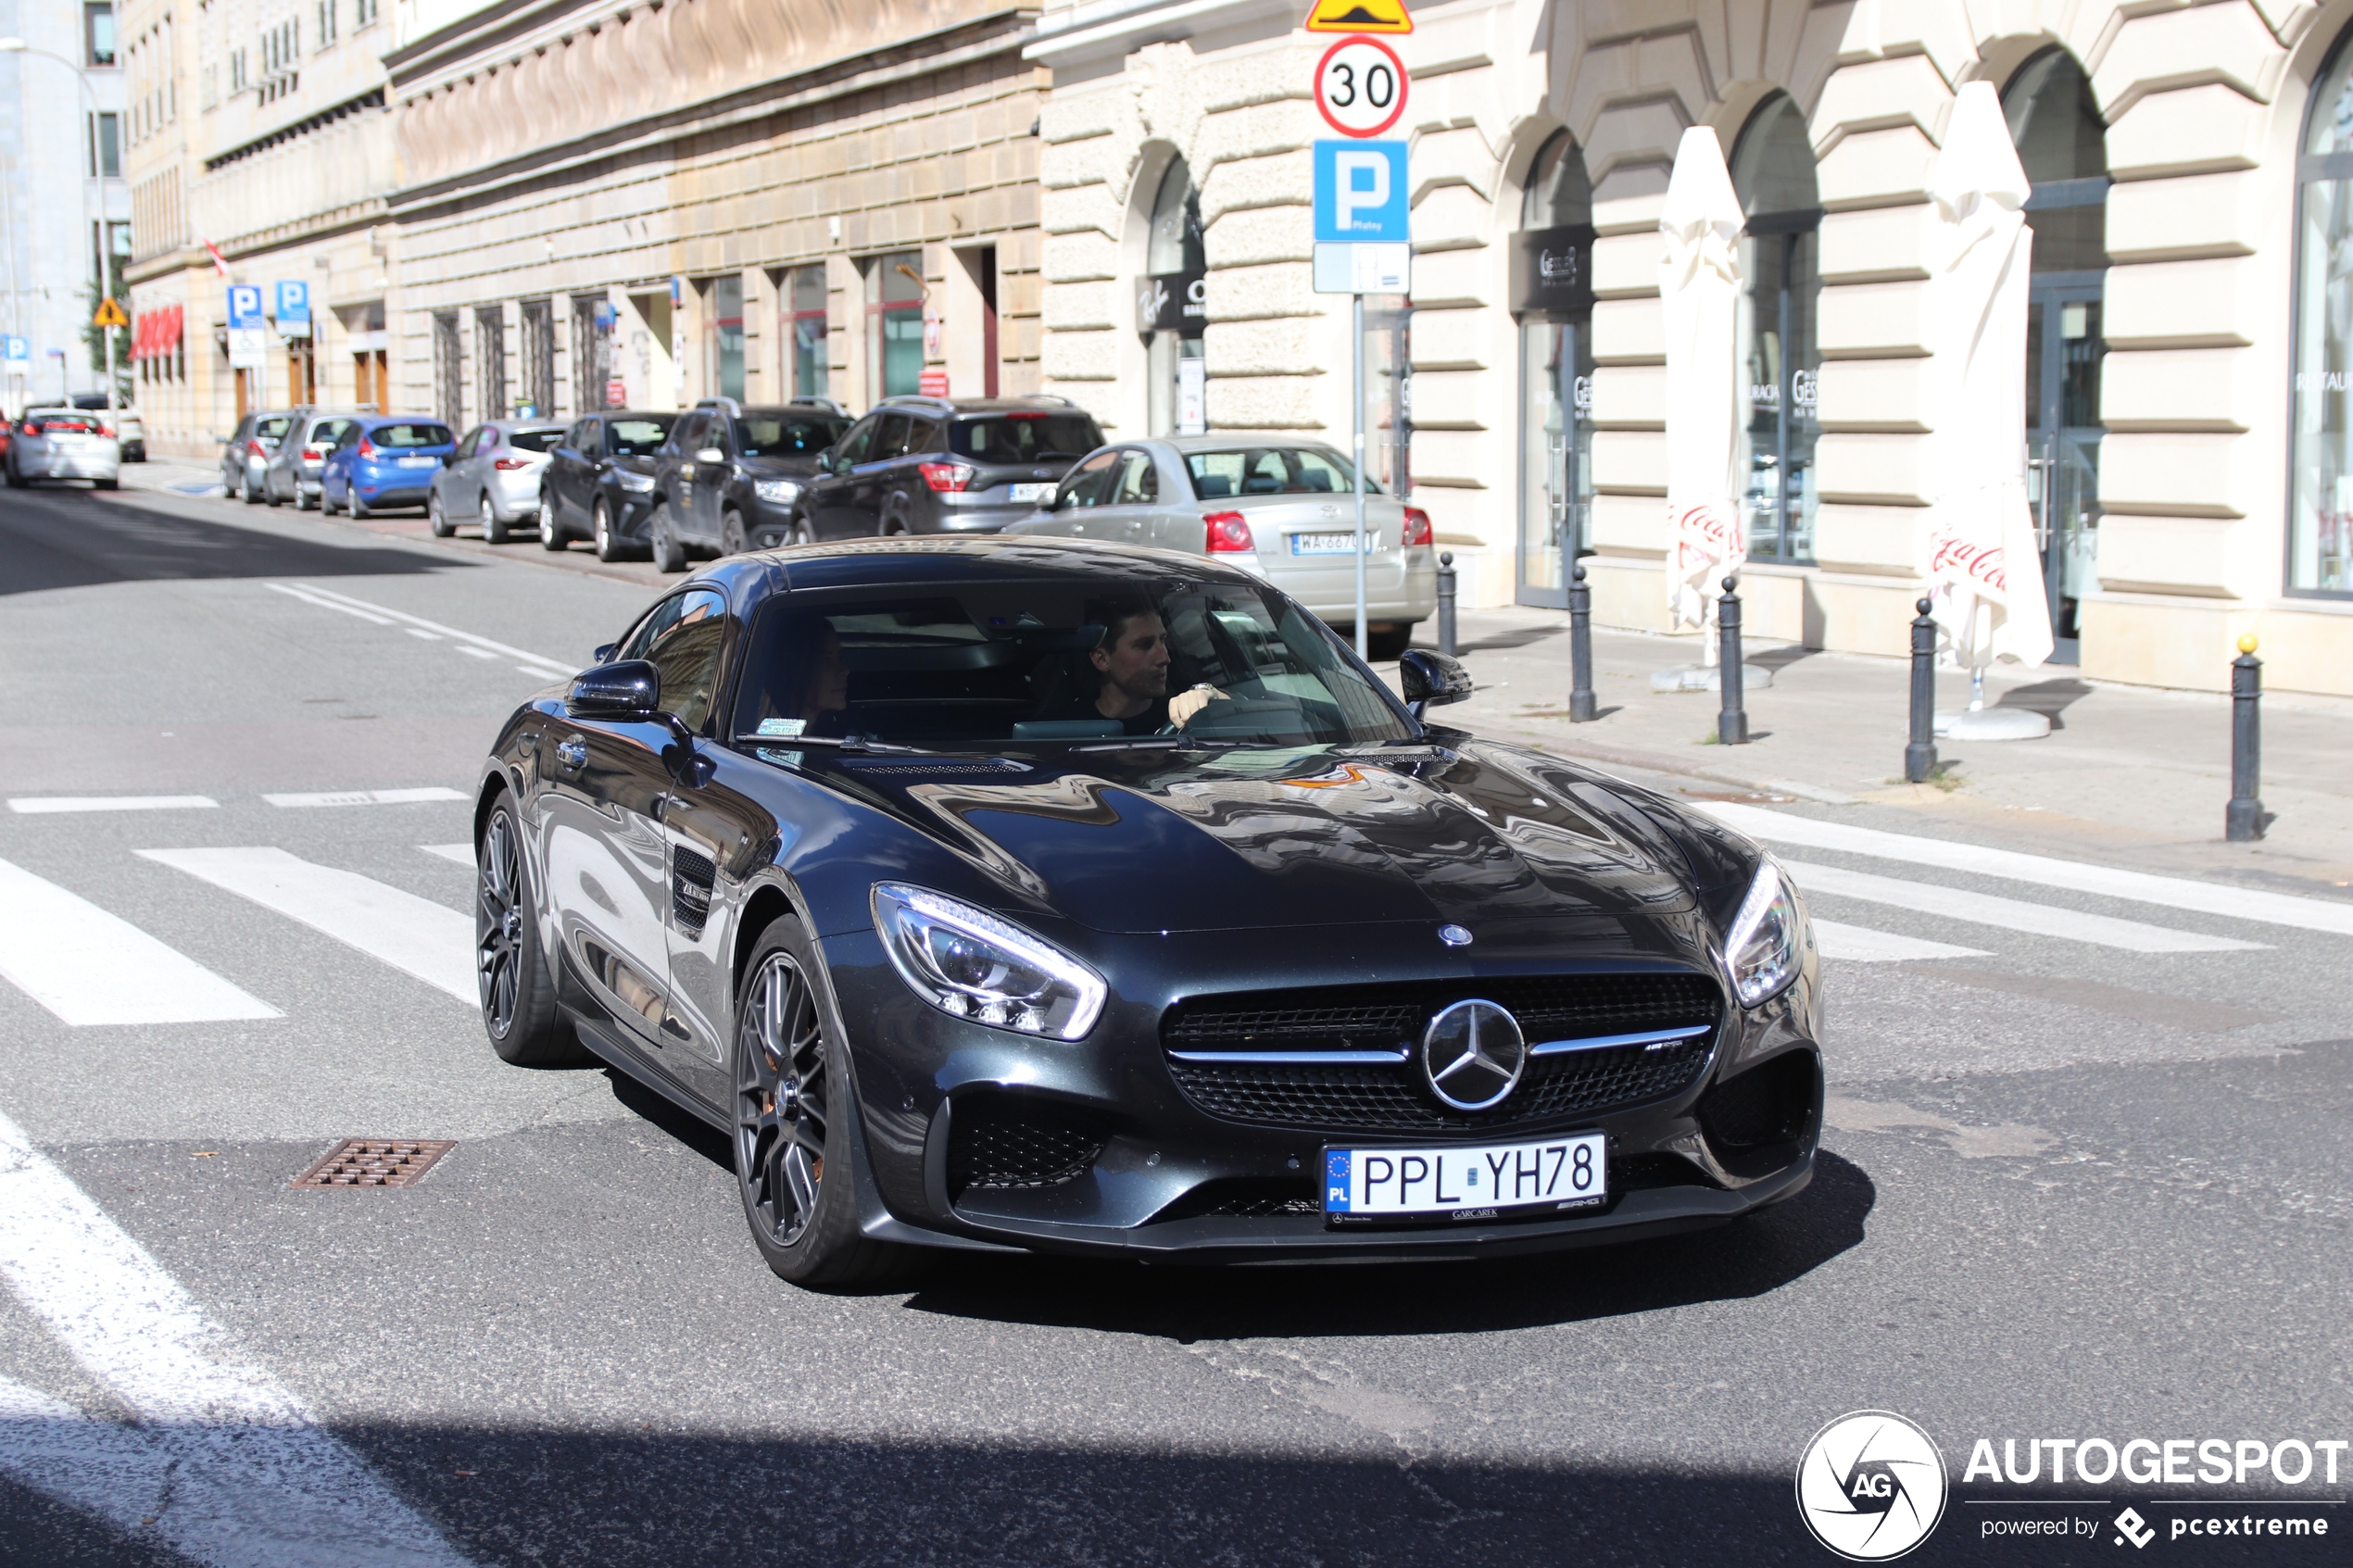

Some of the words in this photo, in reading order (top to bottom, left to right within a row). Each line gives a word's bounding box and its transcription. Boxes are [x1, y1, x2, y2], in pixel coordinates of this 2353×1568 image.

[1330, 63, 1393, 107] 30
[1335, 151, 1390, 231] P
[233, 287, 258, 320] P
[282, 283, 304, 310] P
[1302, 534, 1321, 549] WA
[1365, 1155, 1461, 1205] PPL
[1485, 1143, 1593, 1200] YH78
[1329, 1187, 1349, 1201] PL
[1452, 1208, 1498, 1220] GARCAREK
